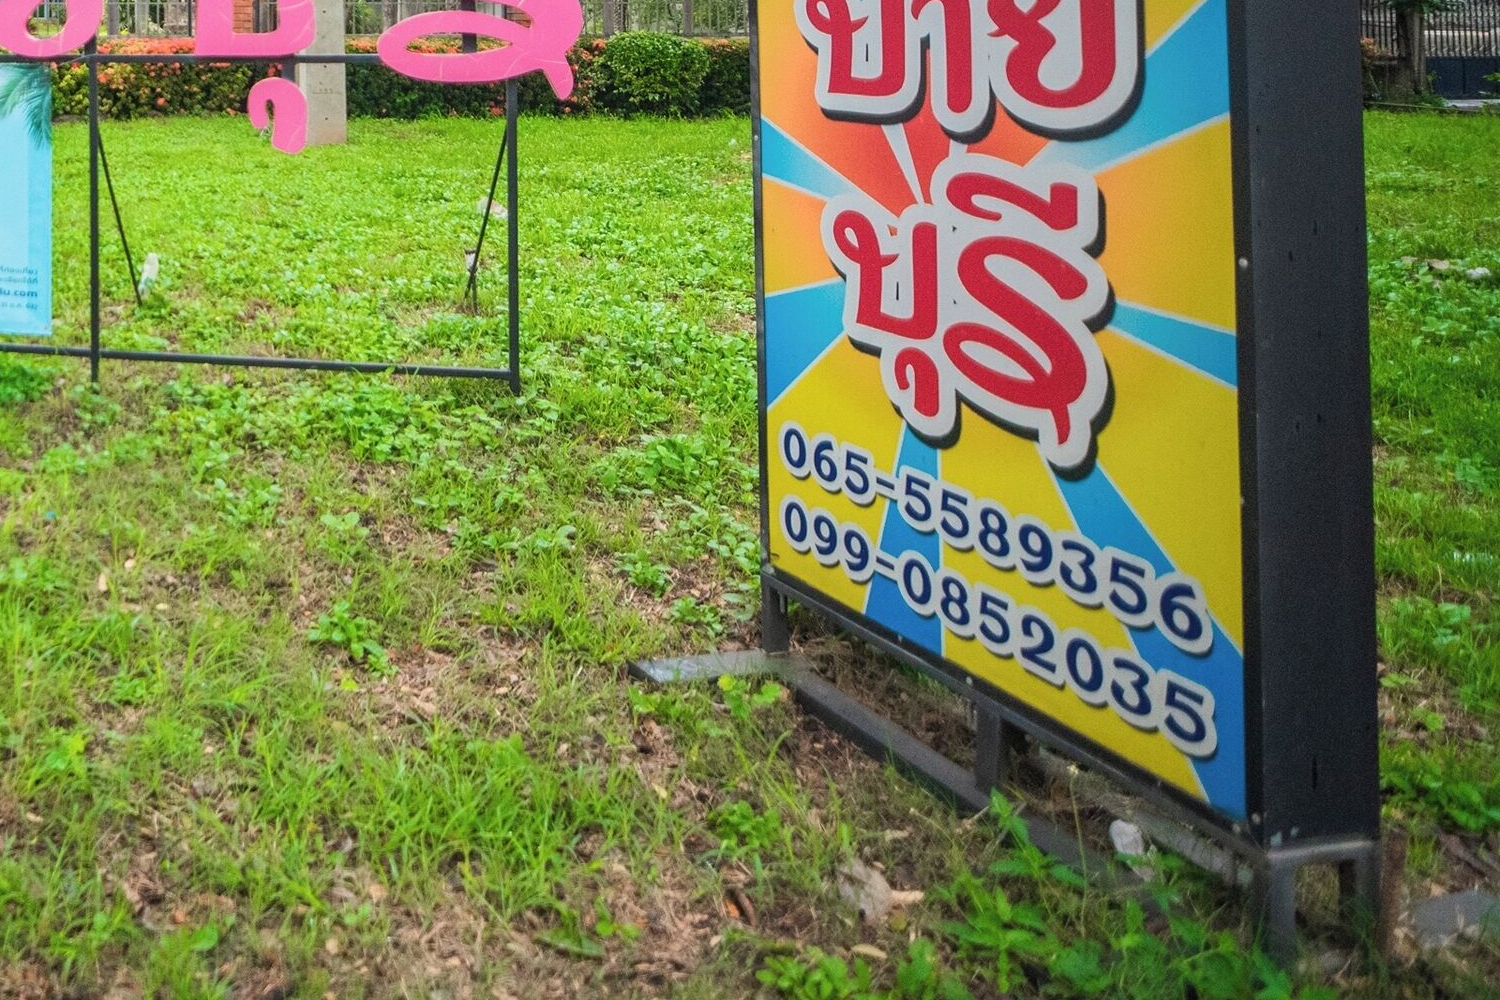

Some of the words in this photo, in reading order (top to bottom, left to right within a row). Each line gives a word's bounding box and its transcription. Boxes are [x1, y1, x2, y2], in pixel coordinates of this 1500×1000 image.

[833, 173, 1088, 446] บุรี
[782, 426, 1205, 643] 065-5589356
[782, 500, 1208, 744] 099-0852035
